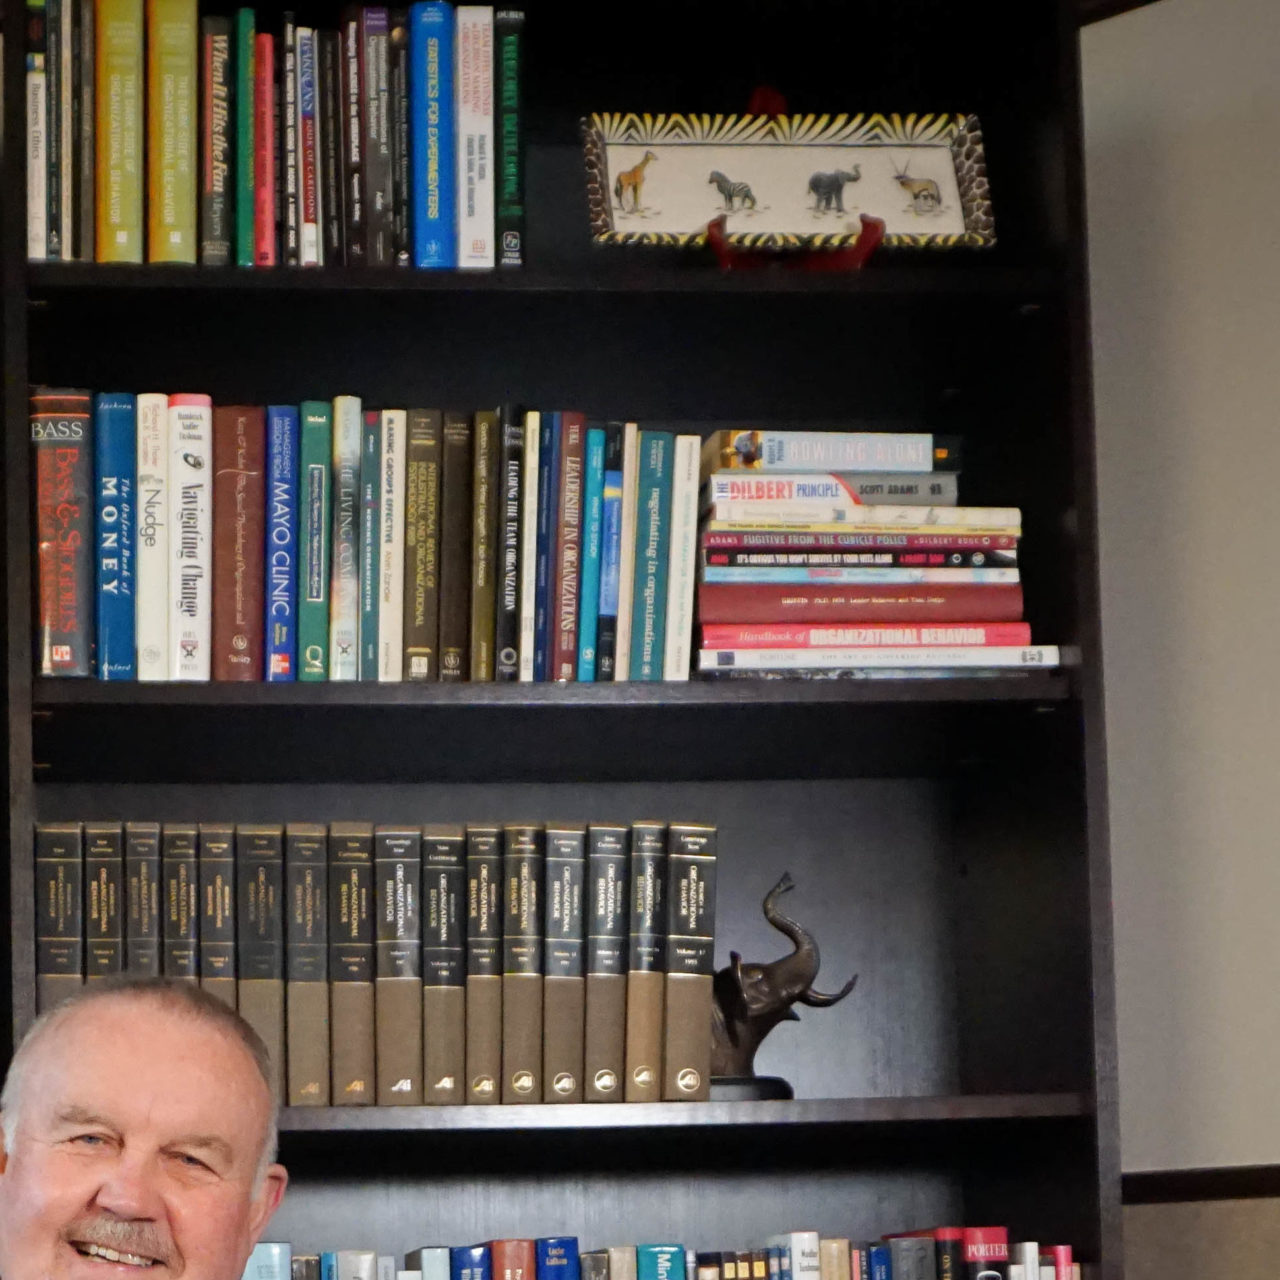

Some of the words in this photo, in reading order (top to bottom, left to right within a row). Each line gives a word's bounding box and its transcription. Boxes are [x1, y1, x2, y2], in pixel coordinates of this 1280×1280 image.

[212, 35, 228, 83] When
[428, 38, 438, 97] STATISTICS
[31, 83, 42, 126] Business
[212, 83, 228, 97] It
[212, 99, 228, 134] Hits
[369, 101, 378, 138] Behavior
[428, 102, 438, 124] FOR
[31, 130, 42, 159] Ethics
[212, 135, 228, 160] the
[212, 161, 228, 193] Fan
[428, 127, 438, 218] EXPERIMENTERS
[32, 421, 83, 438] BASS
[508, 460, 518, 498] LEADING
[564, 456, 580, 524] LEADERSHIP
[729, 480, 793, 500] DILBERT
[796, 483, 840, 497] PRINCIPLE
[140, 489, 164, 547] Nudge
[177, 483, 204, 558] Navigating
[272, 481, 290, 544] MAYO
[507, 501, 518, 517] THE
[646, 488, 660, 557] negotiating
[102, 476, 118, 594] MONEY
[506, 522, 517, 544] TEAM
[564, 528, 578, 540] IN
[272, 551, 290, 615] CLINIC
[506, 548, 517, 610] ORGANIZATION
[648, 560, 658, 573] in
[177, 565, 205, 617] Change
[562, 544, 577, 630] ORGANIZATIONS
[643, 576, 656, 661] organizations
[967, 1245, 1008, 1257] PORTER
